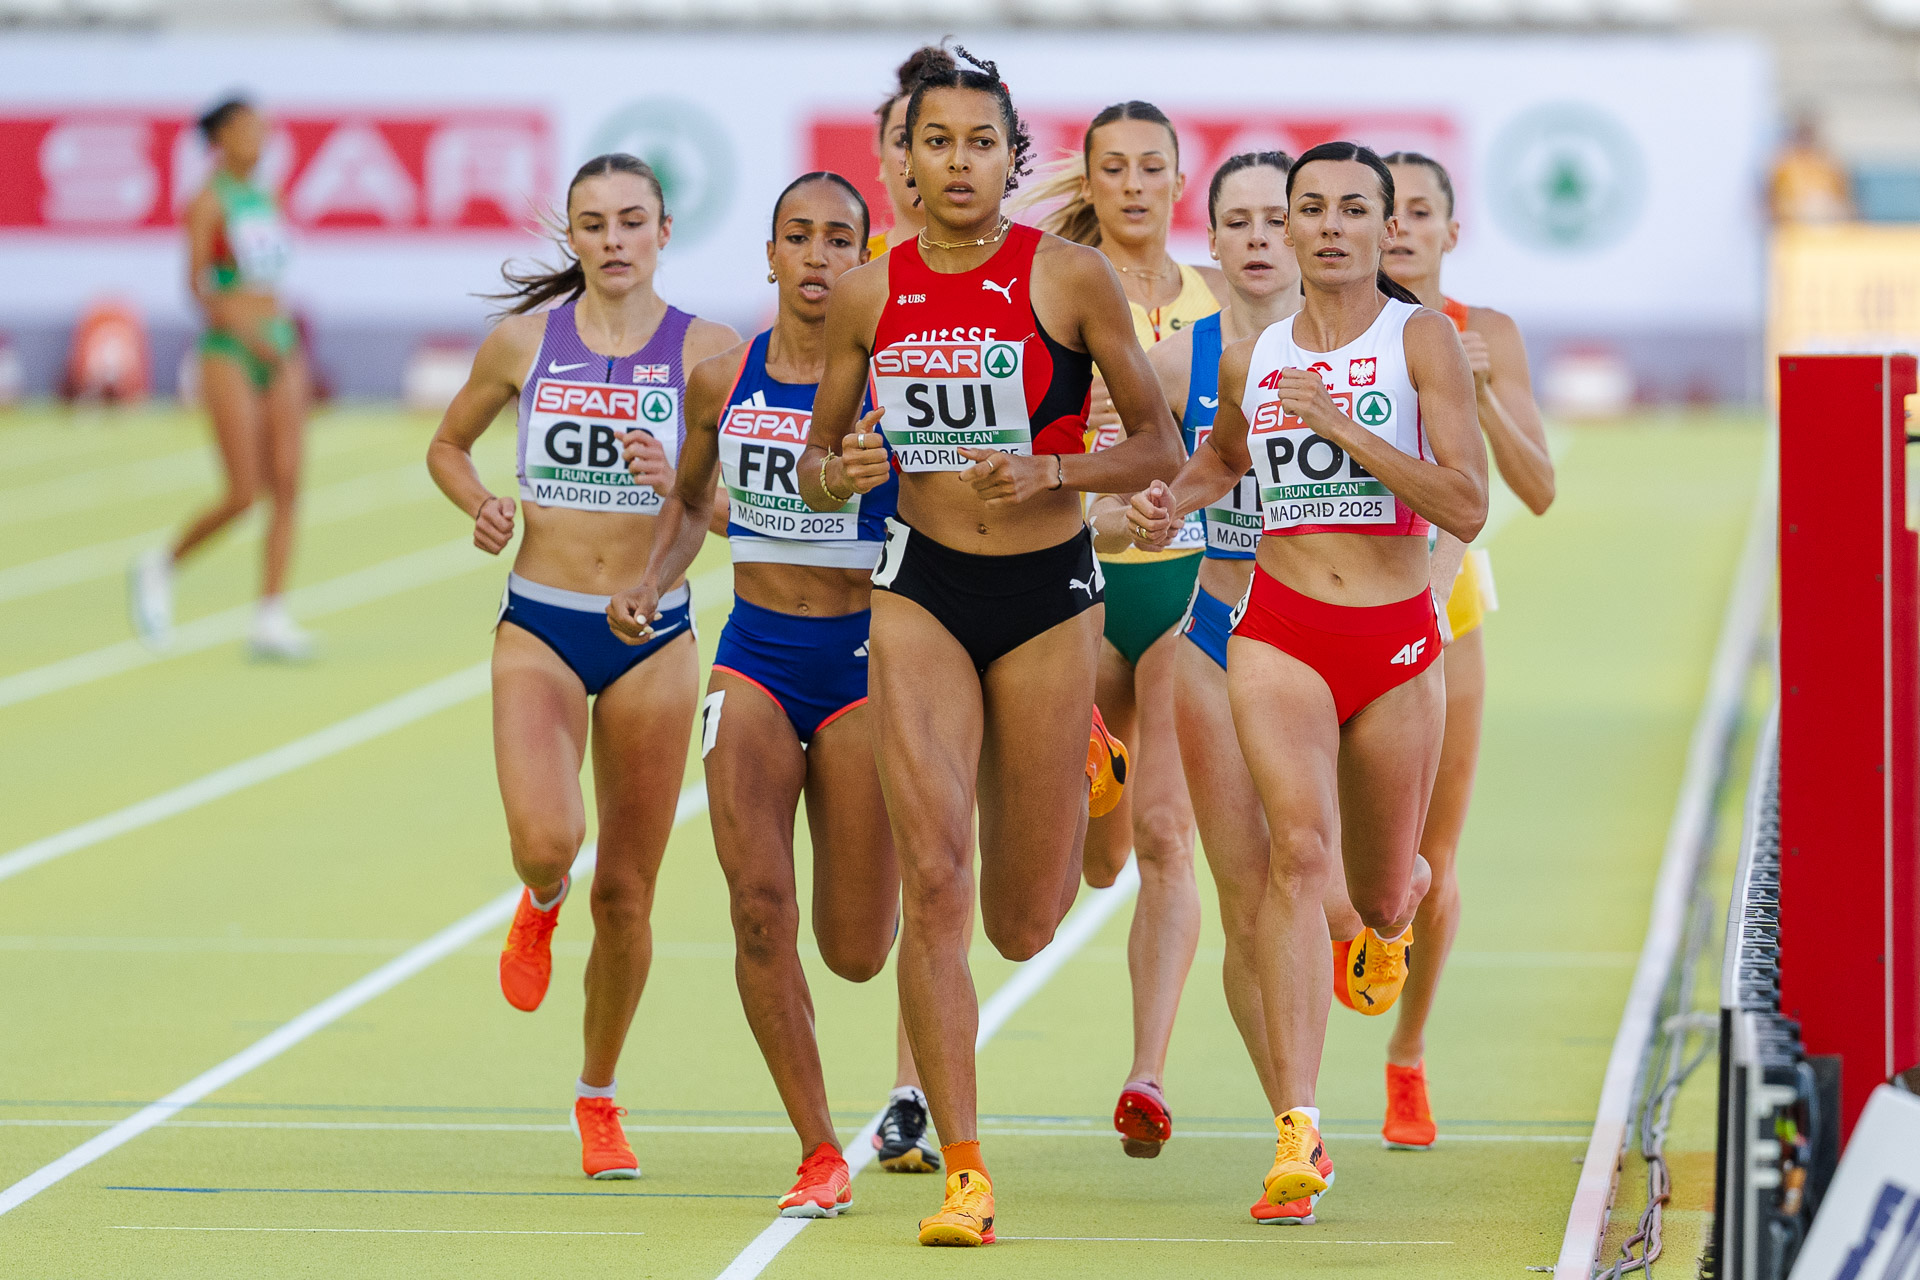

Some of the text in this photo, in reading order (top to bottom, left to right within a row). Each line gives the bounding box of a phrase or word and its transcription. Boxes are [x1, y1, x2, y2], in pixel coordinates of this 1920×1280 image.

[907, 293, 927, 304] UBS
[875, 349, 978, 374] SPAR
[538, 385, 636, 417] SPAR
[904, 383, 997, 429] SUI
[544, 421, 655, 470] GB
[909, 433, 914, 443] I
[916, 432, 945, 444] RUN
[555, 468, 560, 479] I
[561, 469, 590, 482] RUN
[739, 443, 800, 495] FR
[536, 484, 660, 506] MADRID 2025
[745, 492, 814, 513] I RUN CLEA
[1279, 488, 1284, 499] I
[1284, 486, 1310, 499] RUN
[738, 504, 844, 533] MADRID 2025
[1235, 514, 1263, 528] RUN
[1270, 501, 1383, 523] MADRID 2025
[1390, 636, 1427, 666] 4F
